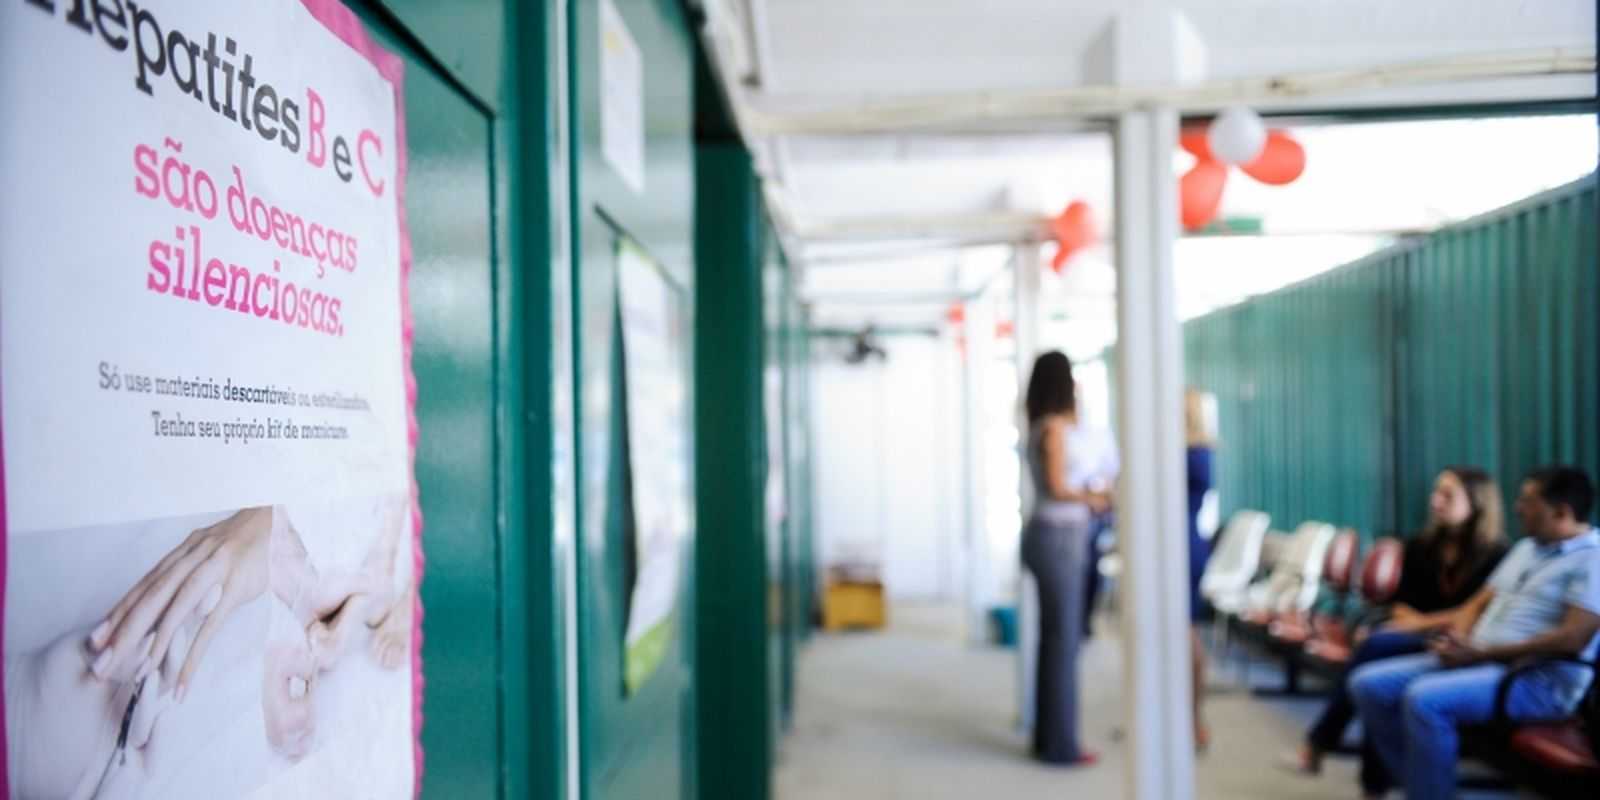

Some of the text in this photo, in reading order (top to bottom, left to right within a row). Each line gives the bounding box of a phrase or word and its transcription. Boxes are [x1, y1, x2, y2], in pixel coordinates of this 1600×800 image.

[24, 0, 385, 197] epatites B e C
[134, 136, 358, 279] são doenças
[147, 225, 343, 337] silenciosas.
[98, 360, 121, 391] Só
[124, 373, 153, 393] use
[154, 376, 221, 400] materiais
[222, 377, 297, 406] descartáveis
[151, 410, 196, 437] Tenha
[198, 421, 221, 437] seu
[222, 417, 265, 444] próprio
[267, 417, 282, 439] kit
[283, 418, 299, 439] de
